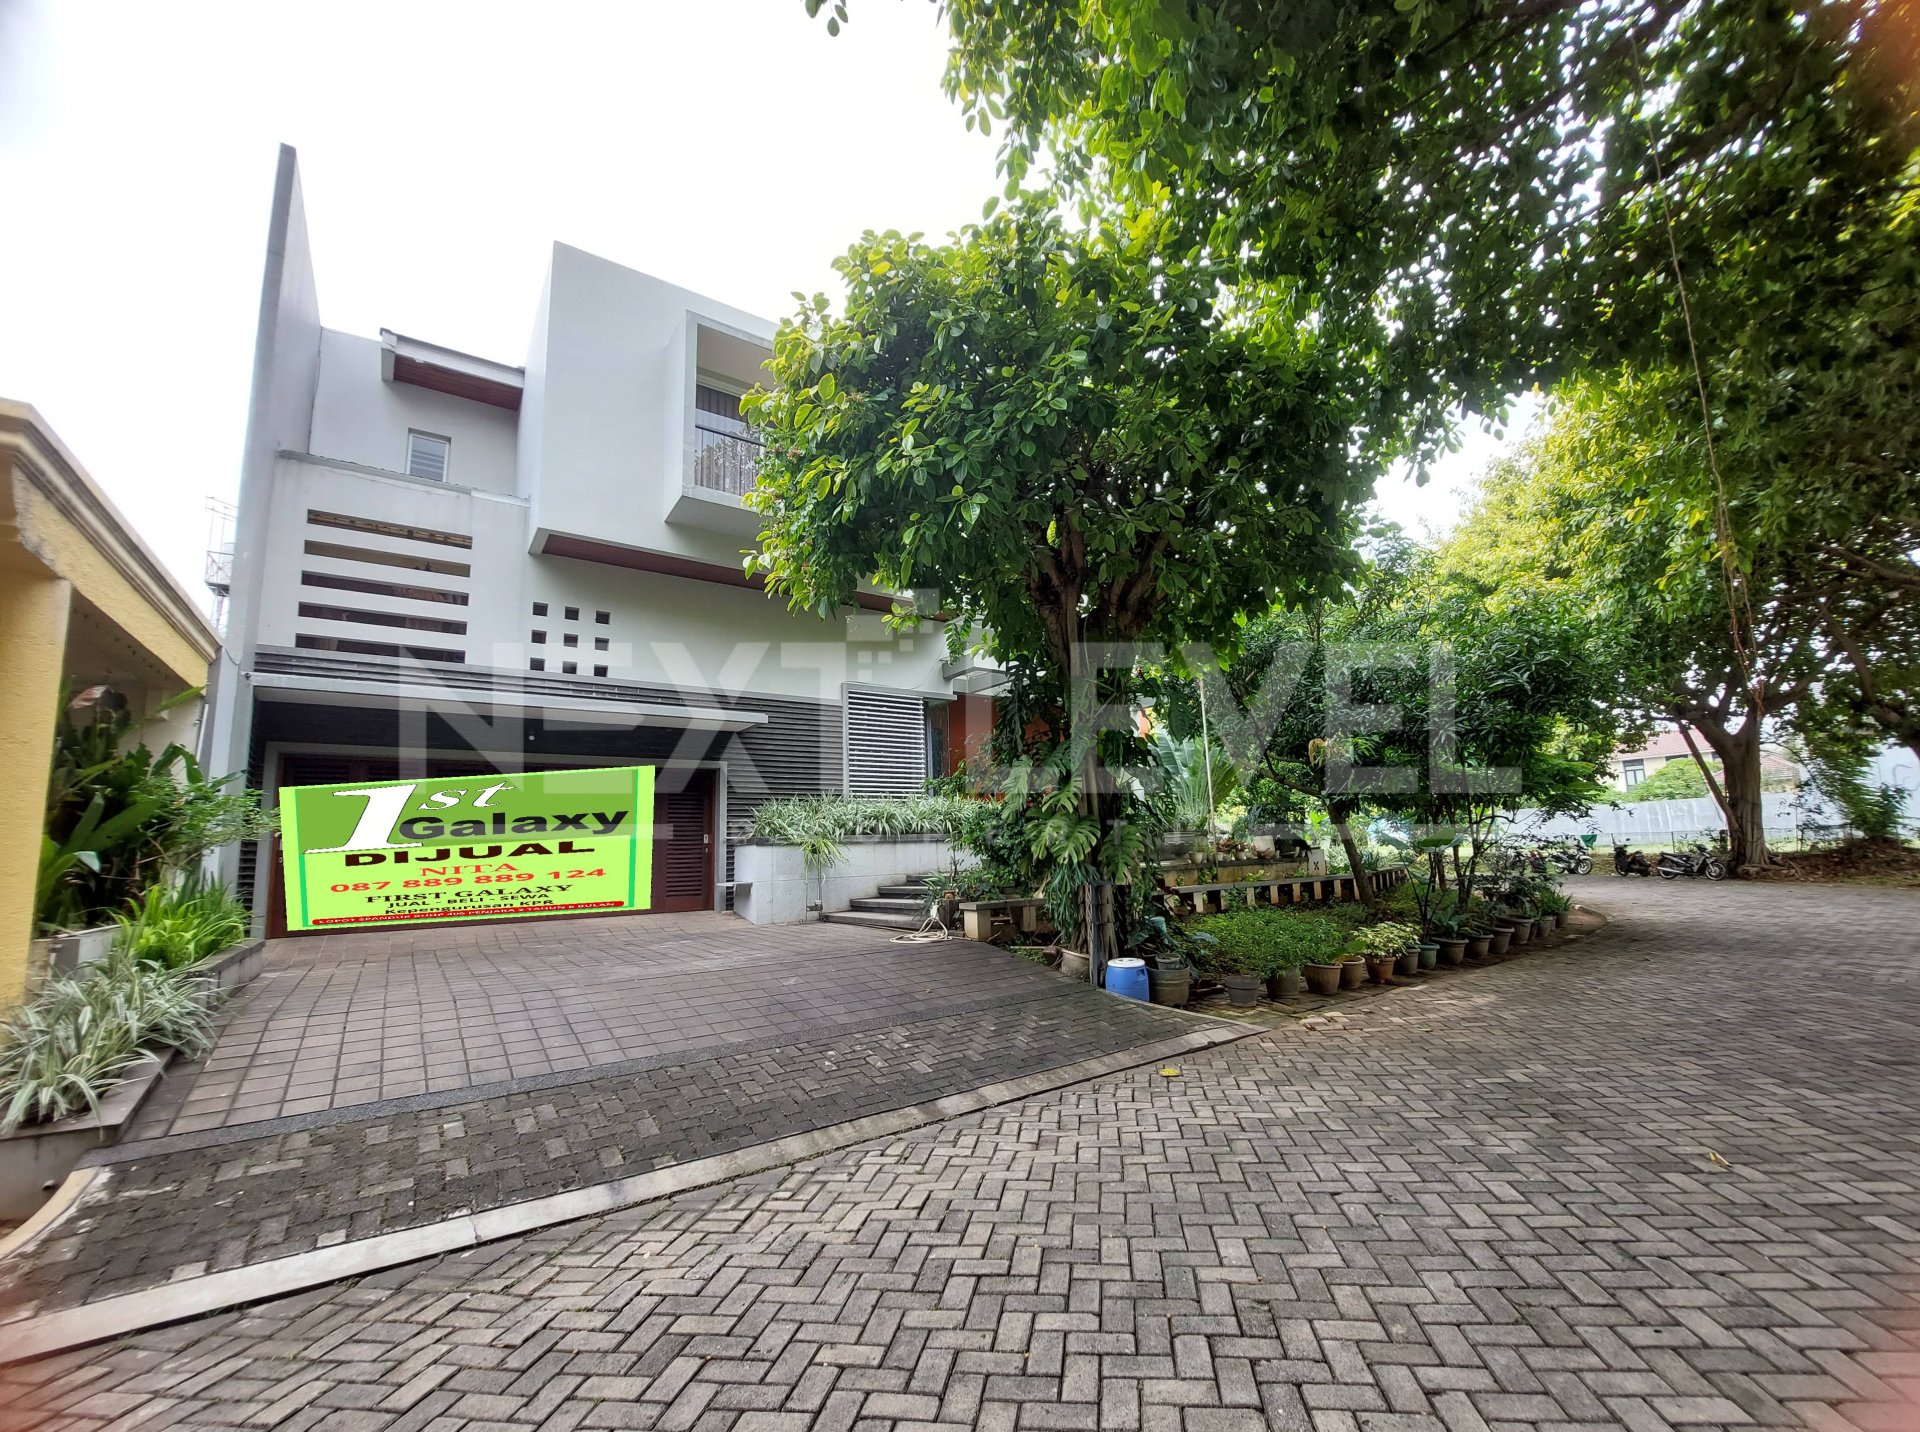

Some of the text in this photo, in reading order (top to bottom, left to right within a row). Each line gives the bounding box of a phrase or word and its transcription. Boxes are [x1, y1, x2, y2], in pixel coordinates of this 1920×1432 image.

[399, 810, 629, 840] Galaxy
[345, 841, 595, 866] DIJUAL
[420, 863, 518, 877] NITA
[330, 868, 607, 893] 087 889 889 124
[366, 885, 573, 903] FIRST GALAXY
[387, 899, 428, 908] JUAL
[448, 897, 484, 905] BELI
[500, 893, 549, 902] SEWA
[385, 899, 554, 915] Kepengurusan KPR
